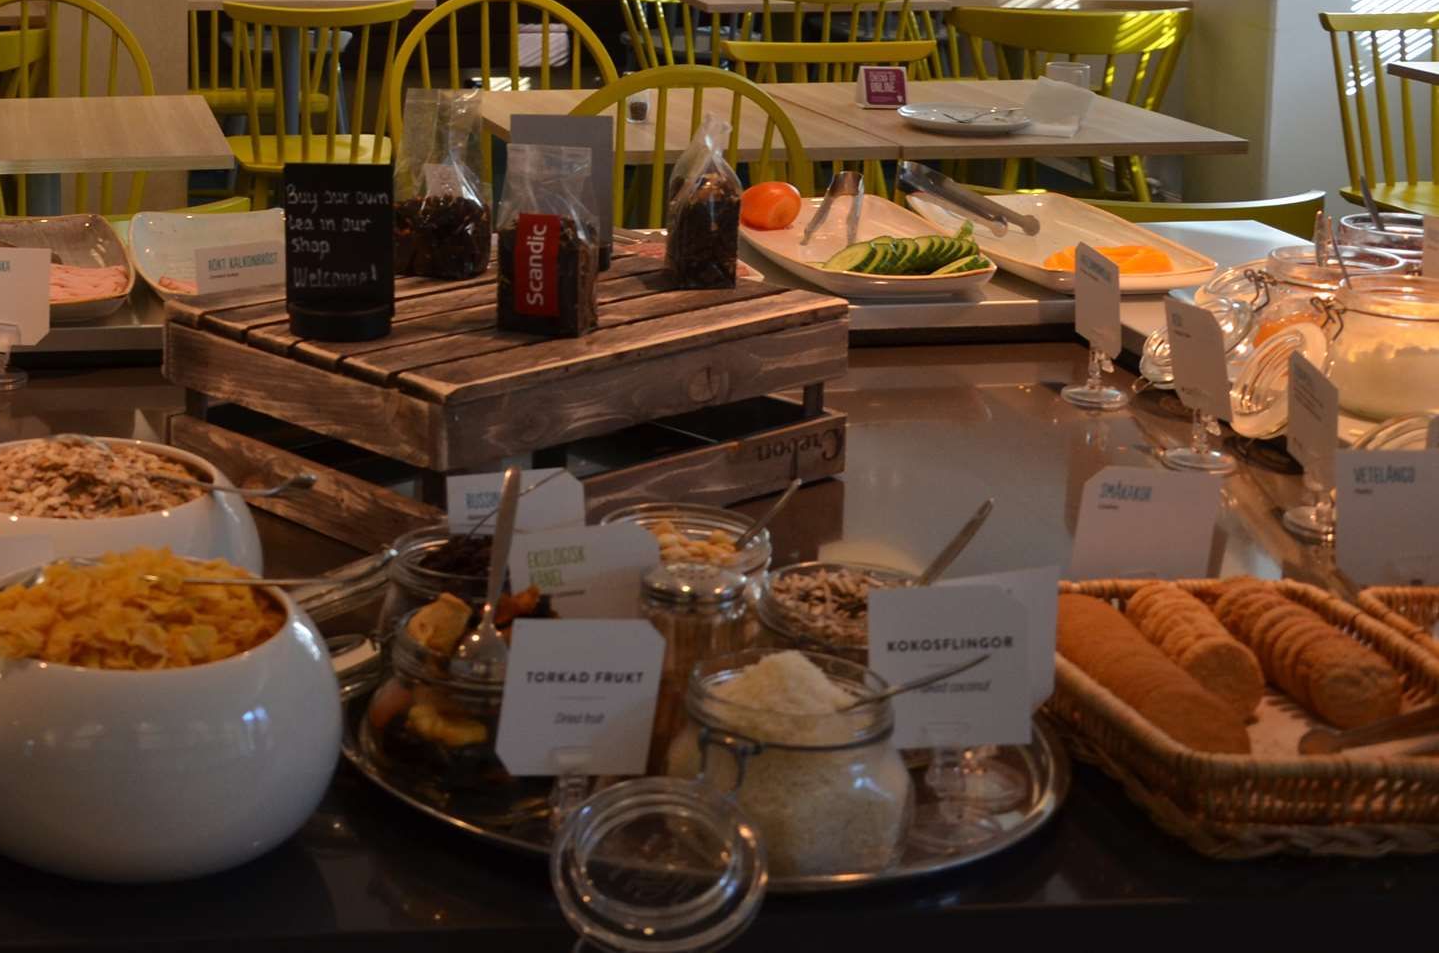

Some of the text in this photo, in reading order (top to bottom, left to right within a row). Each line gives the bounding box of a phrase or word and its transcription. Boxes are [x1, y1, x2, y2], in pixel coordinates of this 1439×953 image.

[286, 183, 318, 214] Buy
[356, 191, 389, 205] own
[320, 217, 336, 231] in
[342, 217, 371, 232] our
[526, 224, 547, 306] Scandic
[887, 635, 1013, 652] KOKOSFLINGOR
[526, 670, 644, 684] TORKAD FRUKT
